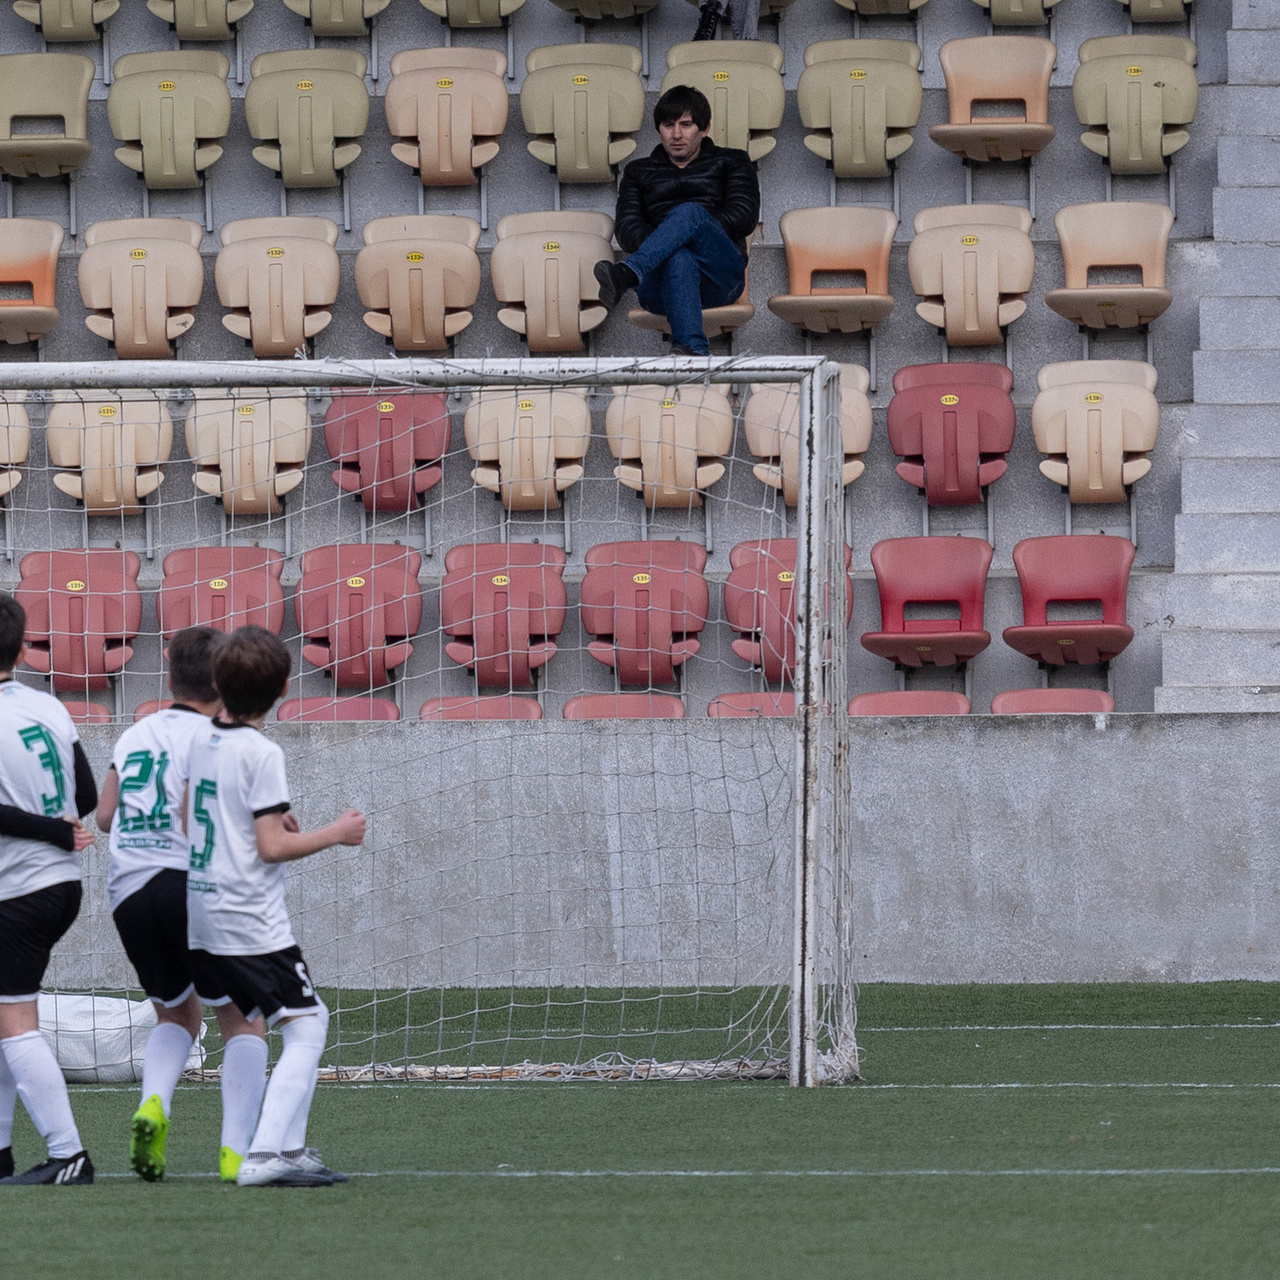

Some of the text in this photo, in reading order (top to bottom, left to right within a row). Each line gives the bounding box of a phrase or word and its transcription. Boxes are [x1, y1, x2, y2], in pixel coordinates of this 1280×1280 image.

[18, 723, 66, 818] 3
[117, 750, 173, 833] 21
[188, 777, 219, 871] 5
